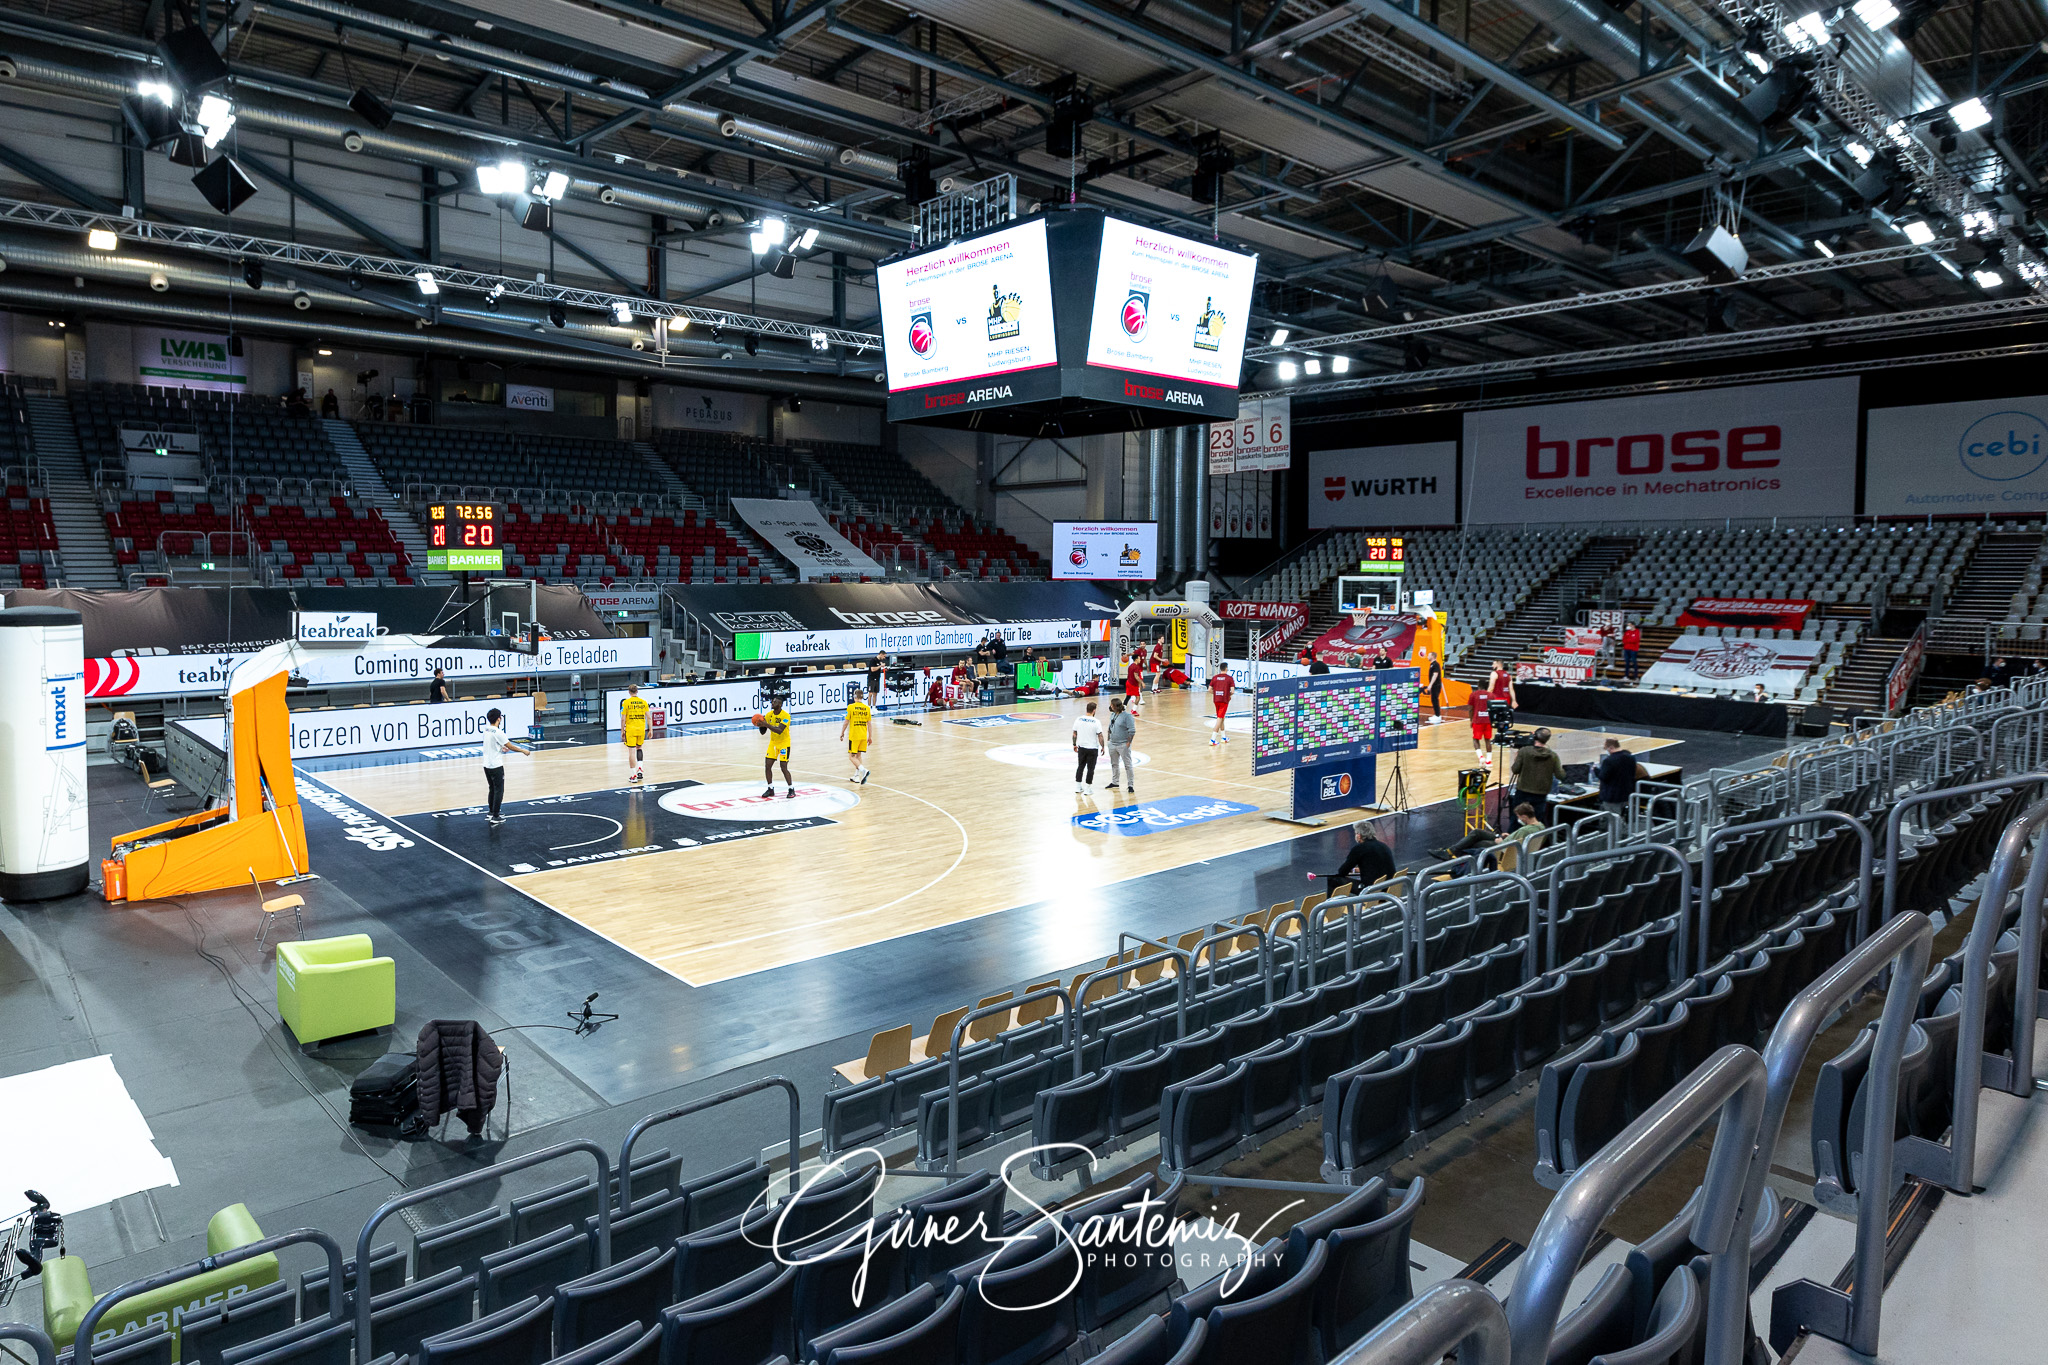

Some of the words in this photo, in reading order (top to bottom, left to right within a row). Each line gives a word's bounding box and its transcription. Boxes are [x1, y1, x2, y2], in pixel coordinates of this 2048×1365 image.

[906, 259, 946, 277] Herzlich
[948, 241, 1010, 265] willkommen
[1135, 236, 1174, 255] Herzlich
[1177, 249, 1229, 269] willkommen
[967, 259, 988, 270] BROSE
[991, 253, 1014, 263] ARENA
[1130, 272, 1153, 284] brose
[909, 296, 931, 308] brose
[987, 316, 1002, 326] MHP
[160, 338, 205, 360] LVM
[987, 350, 1003, 359] MHP
[1004, 345, 1030, 356] RIESEN
[1106, 347, 1125, 357] Brose
[1126, 351, 1153, 363] Bamberg
[161, 359, 227, 370] VERSICHERUNG
[988, 355, 1031, 368] Ludwigsburg
[903, 370, 920, 378] Brose
[921, 365, 949, 376] Bamberg
[925, 391, 966, 409] brose
[966, 385, 1013, 403] ARENA
[1124, 379, 1164, 401] brose
[1165, 390, 1204, 407] ARENA
[685, 408, 732, 421] PEGASUS
[1211, 428, 1234, 449] 23
[1242, 425, 1255, 444] 5
[1269, 423, 1282, 443] 6
[1236, 445, 1261, 454] brose
[1263, 444, 1289, 453] brose
[1525, 424, 1782, 480] brose
[1966, 430, 2041, 458] cebi
[1210, 449, 1234, 458] brose
[1351, 476, 1437, 498] WÜRTH
[1525, 482, 1617, 500] Excellence
[1622, 482, 1638, 496] in
[1645, 476, 1781, 495] Mechatronics
[1905, 493, 1995, 504] Automotive
[464, 525, 493, 546] 20
[428, 555, 447, 565] BARMER
[449, 555, 500, 565] BARMER
[1370, 547, 1386, 560] 20
[621, 597, 655, 605] ARENA
[1155, 605, 1178, 614] radio
[828, 607, 947, 625] brose
[1226, 603, 1257, 617] ROTE
[1259, 604, 1298, 619] WAND
[1591, 611, 1621, 624] SSB
[300, 622, 375, 640] teabreak
[865, 633, 878, 649] Im
[880, 632, 913, 648] Herzen
[915, 633, 932, 646] von
[935, 629, 973, 647] Bamberg
[1003, 628, 1016, 641] für
[1018, 627, 1032, 641] Tee
[1260, 631, 1282, 655] ROTE
[1282, 615, 1305, 640] WAND
[182, 645, 267, 655] DEVELOPM
[208, 637, 287, 649] COMMERCIAL
[786, 638, 830, 653] teabreak
[355, 653, 419, 677] Coming
[425, 655, 463, 672] soon
[488, 650, 512, 669] der
[556, 645, 618, 665] Teeladen
[178, 666, 230, 684] teabr
[1534, 664, 1586, 680] SEKTION
[50, 686, 67, 739] maxit
[689, 696, 728, 716] soon
[371, 720, 408, 742] von
[677, 788, 828, 811] brose
[1323, 787, 1337, 798] BBL
[704, 826, 772, 841] FREAK
[772, 820, 814, 830] CITY
[547, 844, 663, 867] BAMBERG
